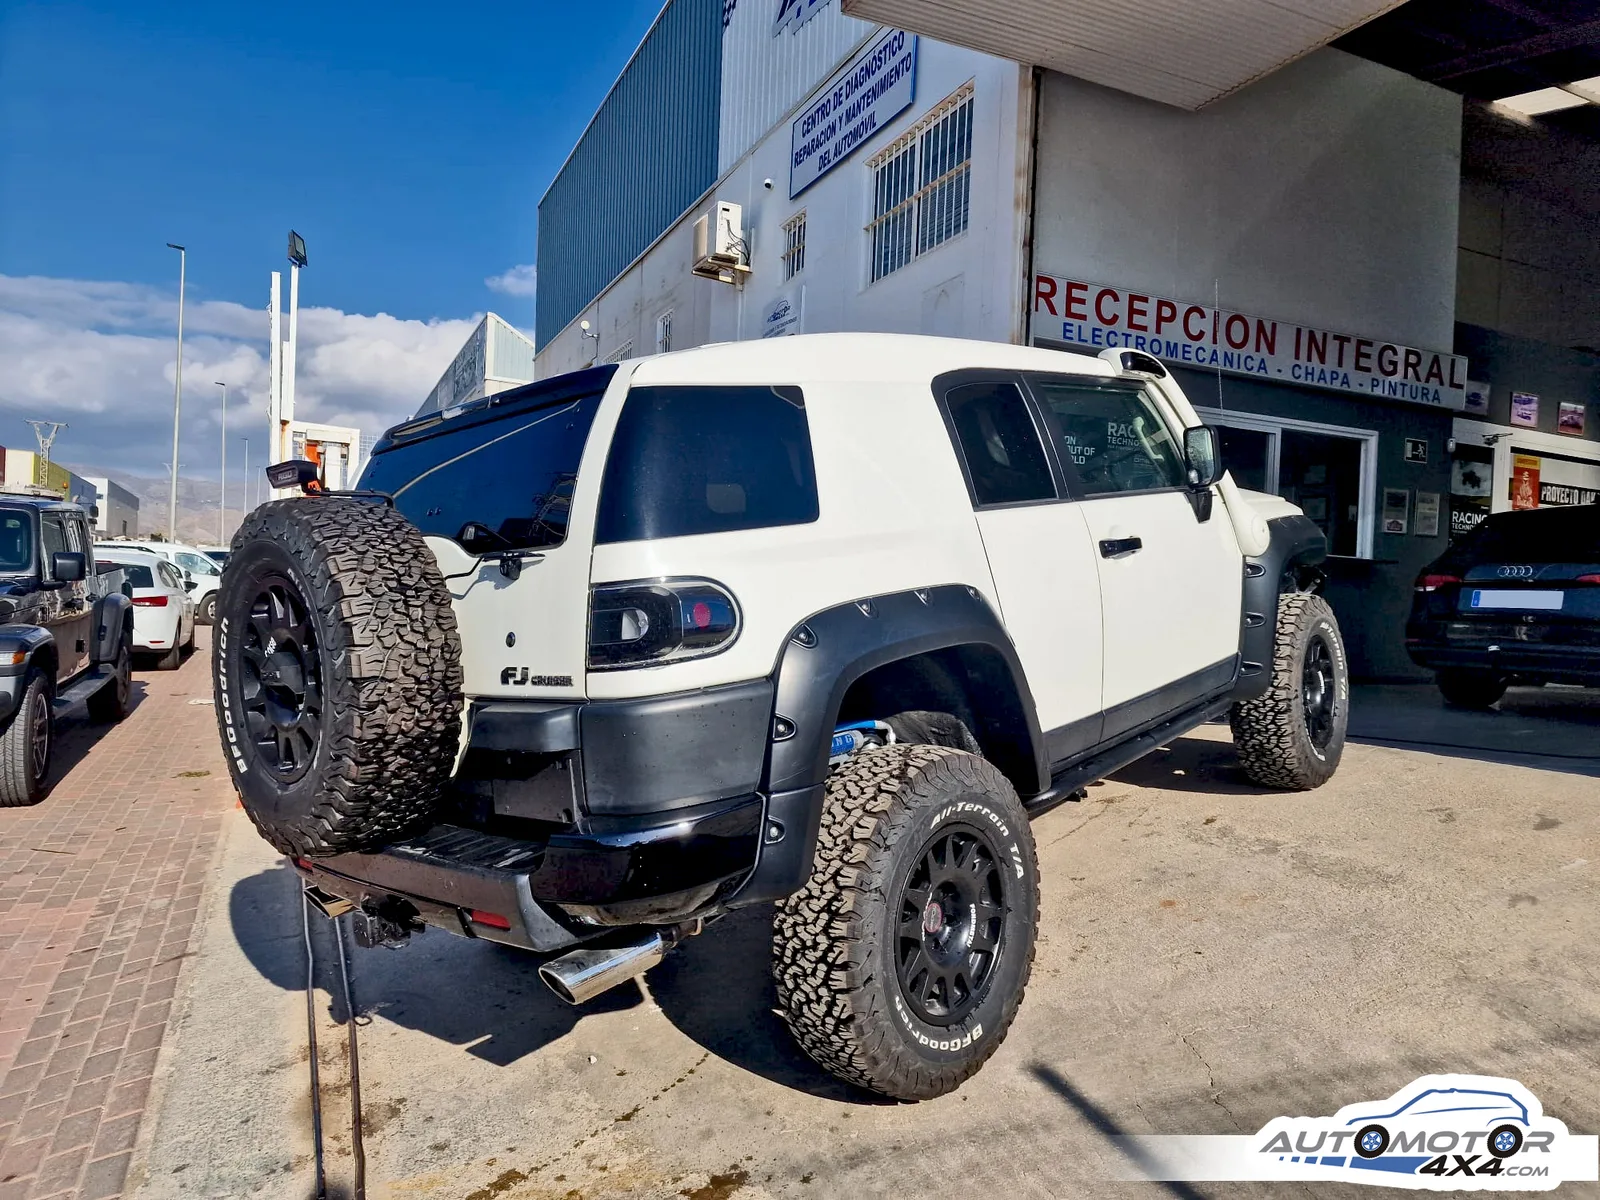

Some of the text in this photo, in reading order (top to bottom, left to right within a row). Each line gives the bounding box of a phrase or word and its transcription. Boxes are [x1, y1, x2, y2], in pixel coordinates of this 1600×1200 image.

[794, 52, 912, 168] REPARACIÓN Y MANTENIMIENTO
[802, 30, 905, 138] CENTRO DE DIAGNÓSTICO
[818, 111, 877, 172] DEL AUTOMÓVIL
[1034, 274, 1465, 390] RECEPCION INTEGRAL
[1062, 322, 1269, 374] ELECTROMECANICA
[1291, 363, 1350, 389] CHAPA
[1371, 377, 1441, 404] PINTURA
[1083, 446, 1095, 456] OF
[1541, 485, 1579, 505] PROYECTO
[219, 617, 248, 774] BFGoodrich
[500, 666, 574, 687] FJ CRUISER
[930, 801, 1010, 837] All-Terrain
[1009, 843, 1025, 879] T/A
[894, 995, 983, 1052] BFGoodrich
